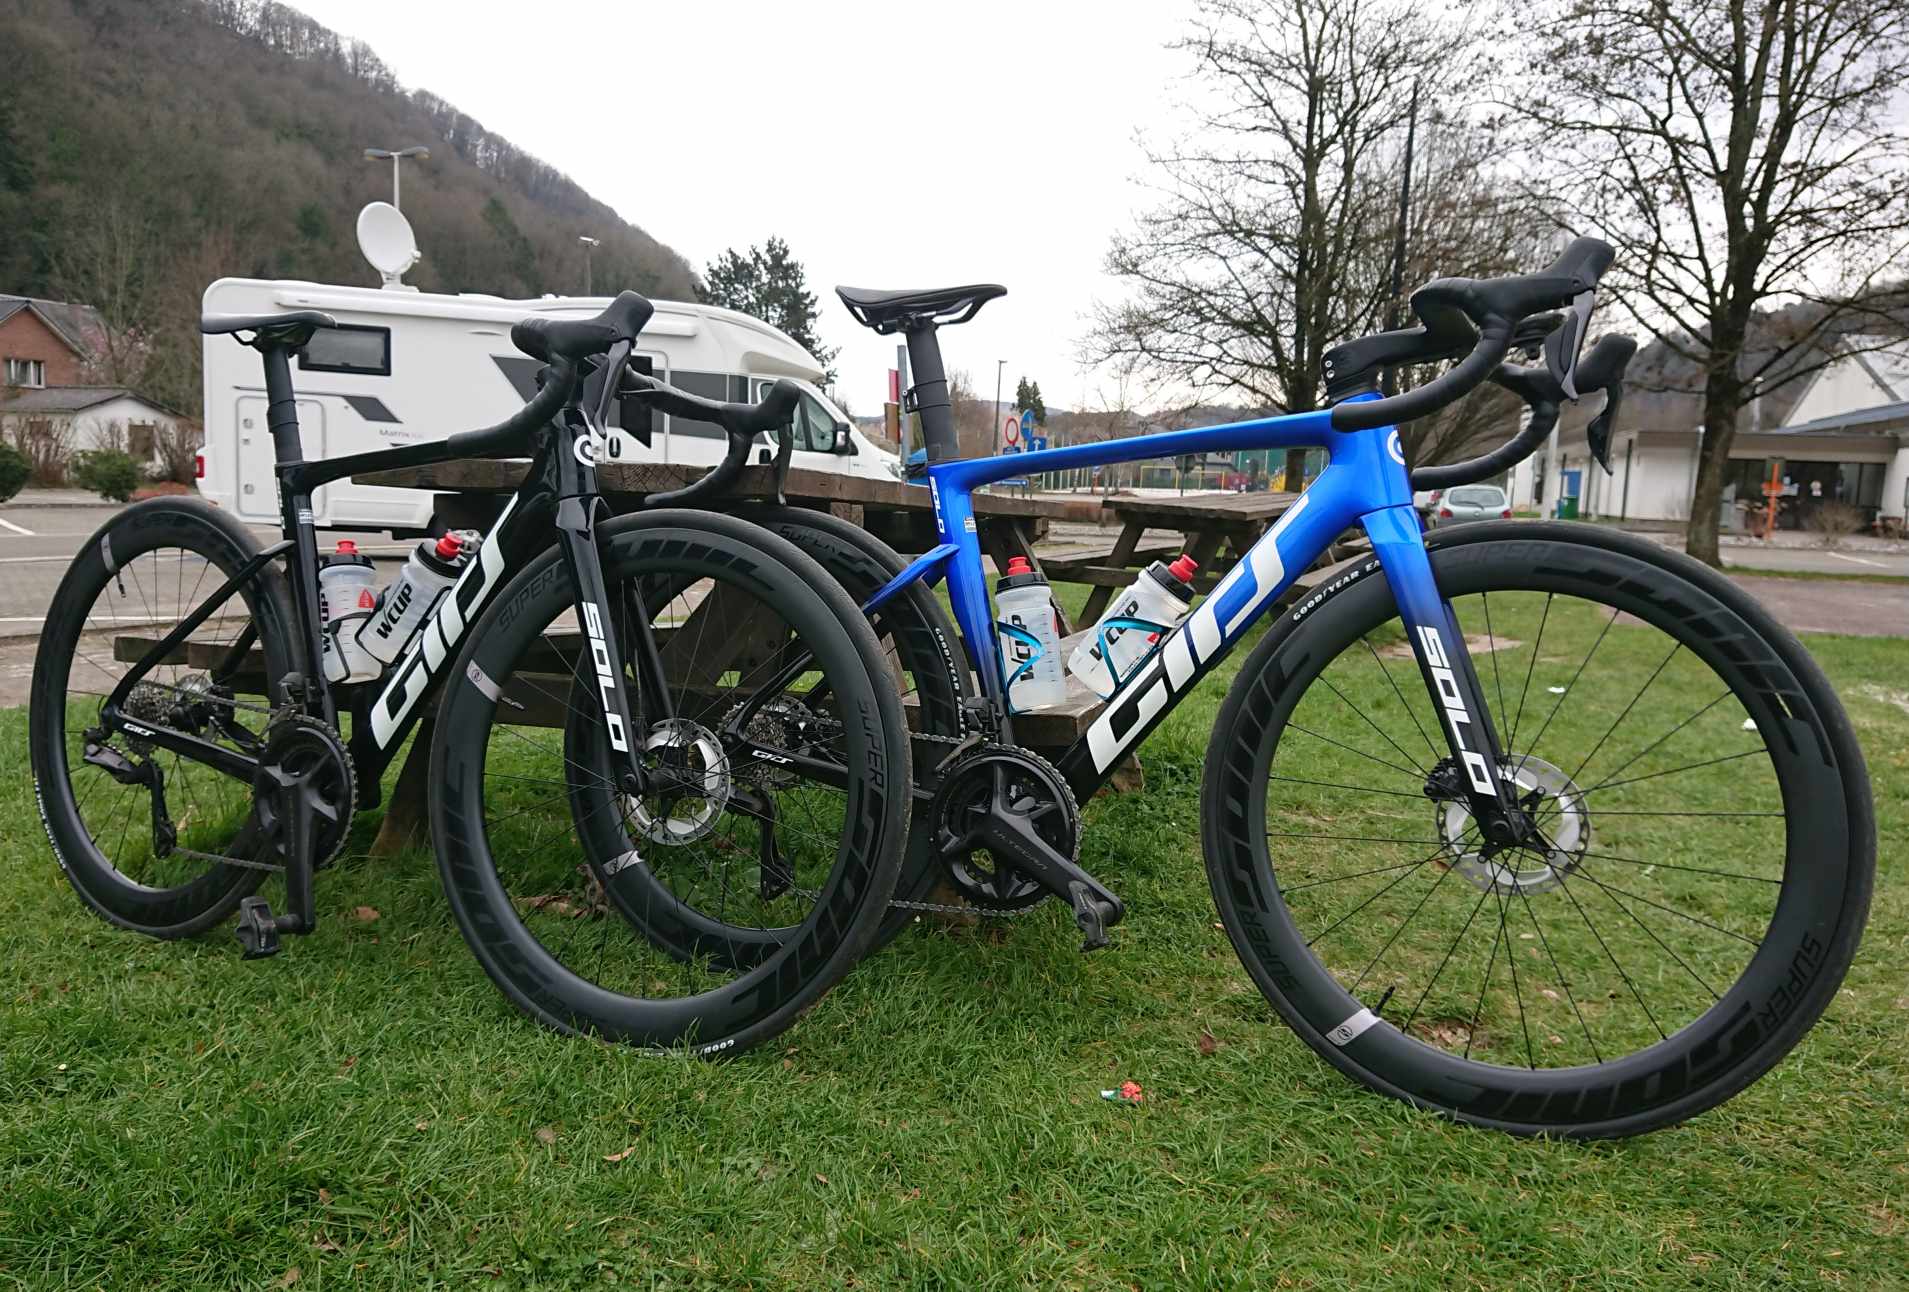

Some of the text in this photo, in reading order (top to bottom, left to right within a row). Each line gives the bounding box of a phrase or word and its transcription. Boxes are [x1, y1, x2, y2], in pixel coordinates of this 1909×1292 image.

[375, 582, 413, 640] WCUP
[582, 601, 629, 753] SOLO
[1416, 625, 1498, 798] SOLO
[1761, 930, 1824, 1035] SUPER
